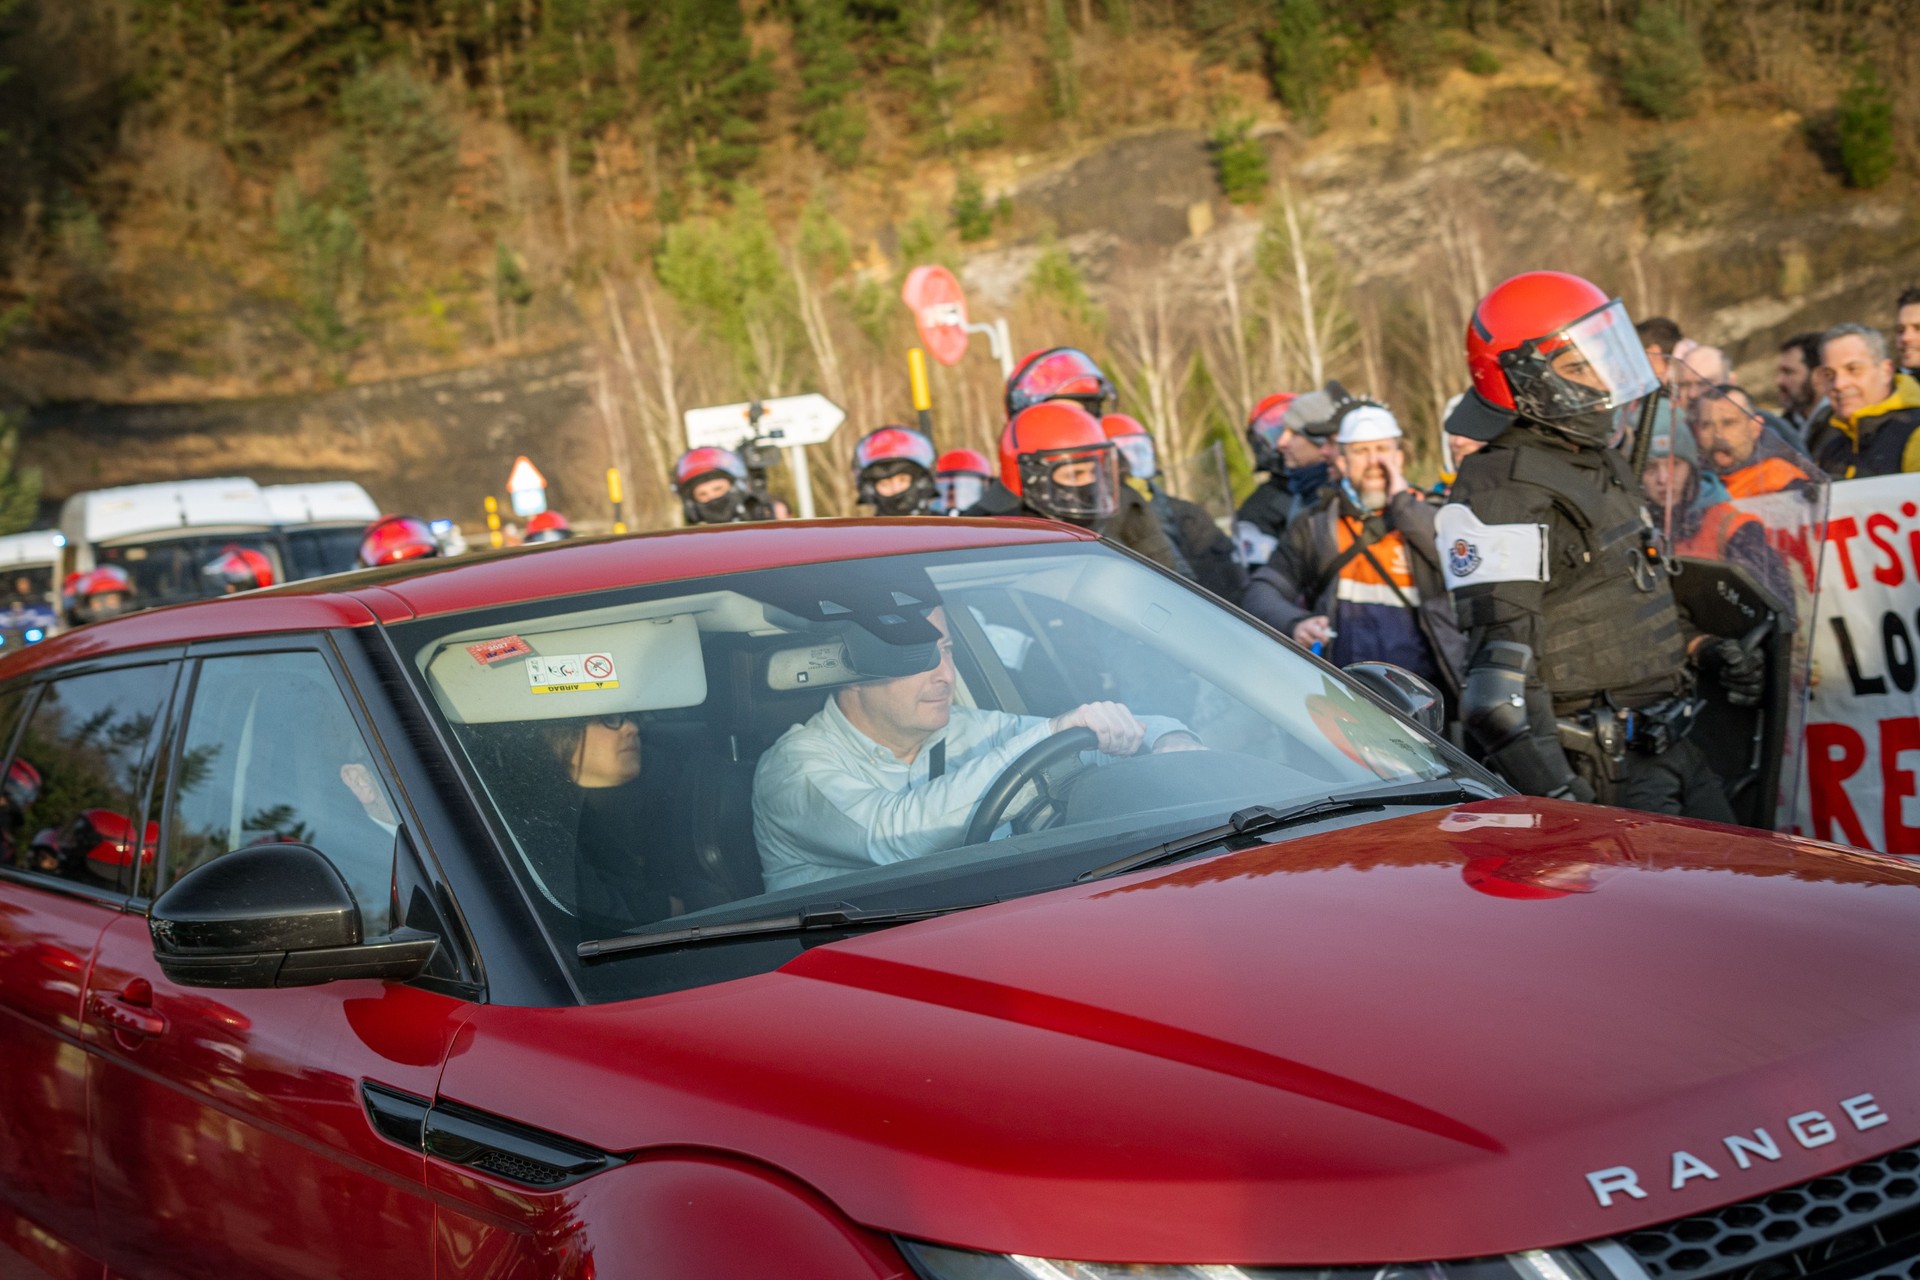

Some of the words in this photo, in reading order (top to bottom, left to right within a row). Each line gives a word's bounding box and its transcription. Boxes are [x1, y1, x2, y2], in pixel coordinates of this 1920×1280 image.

[1766, 502, 1920, 594] NTSi
[548, 684, 579, 692] AIRBAG
[1829, 608, 1920, 696] LO
[1778, 717, 1920, 854] RE
[1585, 1093, 1889, 1207] RANGE
